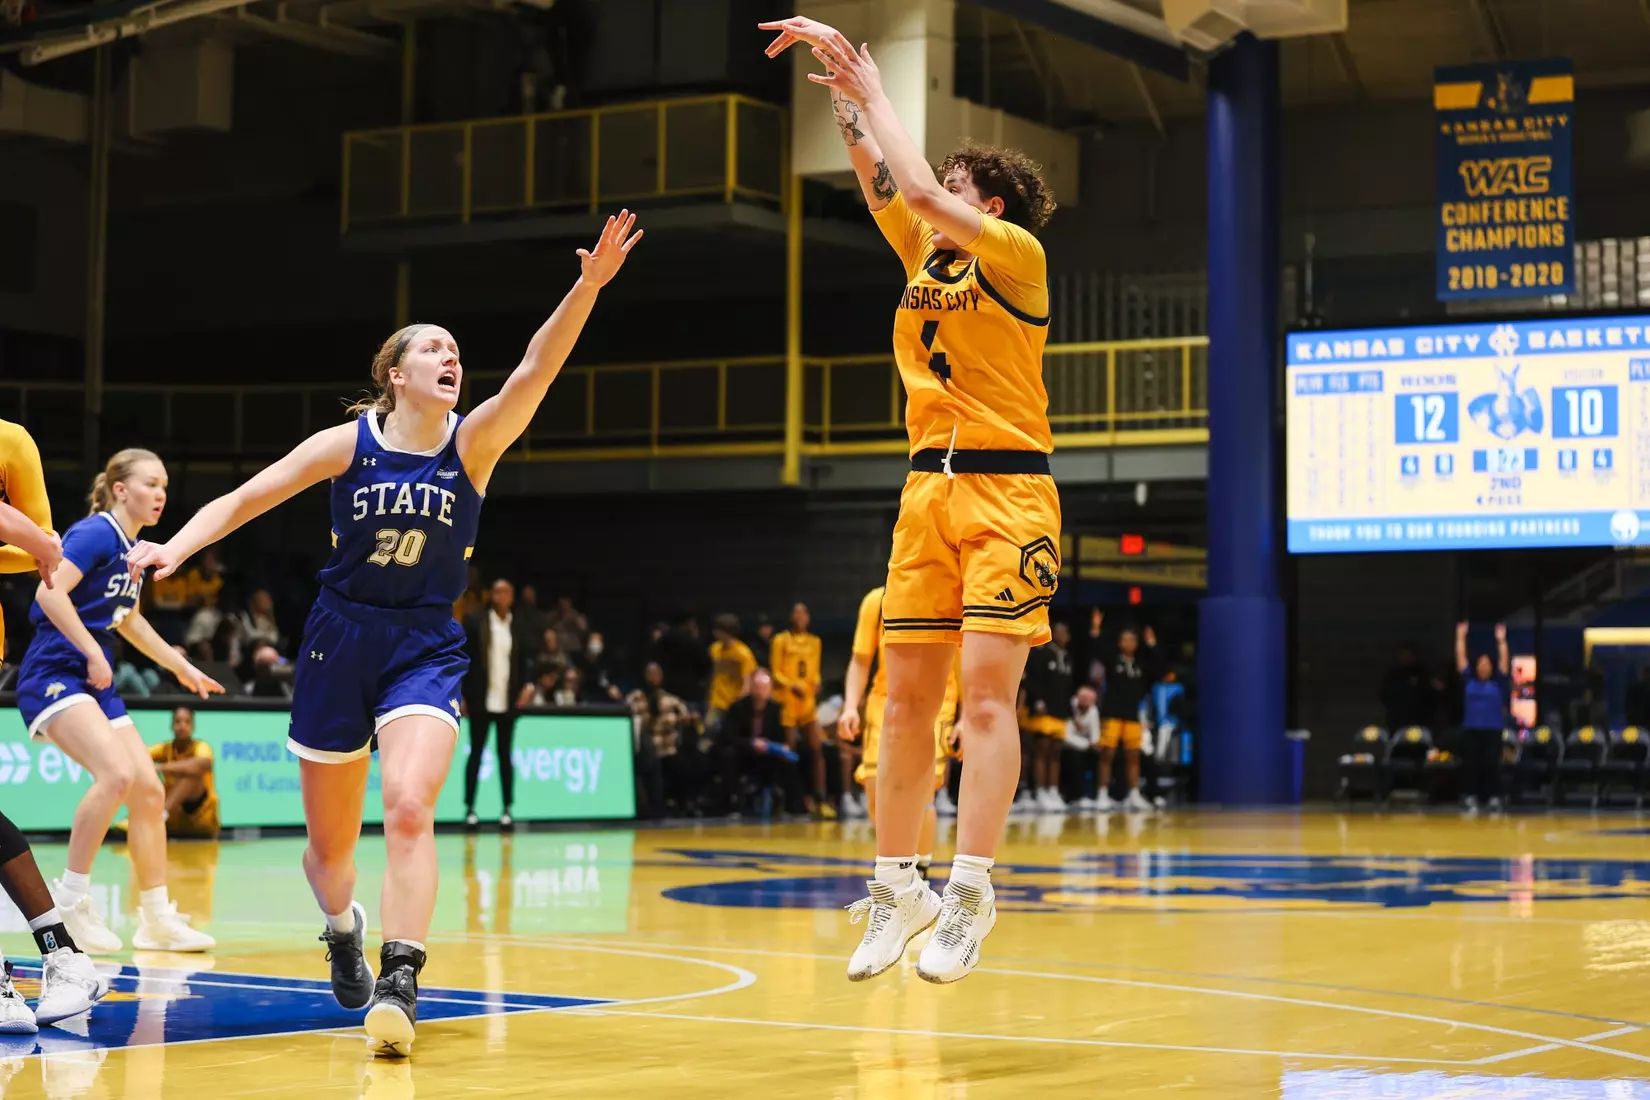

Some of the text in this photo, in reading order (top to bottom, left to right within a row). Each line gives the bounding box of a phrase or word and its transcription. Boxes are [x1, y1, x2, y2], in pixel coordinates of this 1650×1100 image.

[1458, 155, 1552, 196] WAC
[1442, 196, 1569, 226] CONFERENCE
[1446, 223, 1565, 252] CHAMPIONS
[945, 289, 979, 311] CITY
[920, 320, 951, 383] 4
[1296, 337, 1405, 360] KANSAS
[1416, 334, 1480, 355] CITY
[1411, 394, 1446, 441] 12
[1565, 389, 1604, 436] 10
[353, 482, 456, 526] STATE
[367, 528, 427, 567] 20
[510, 746, 603, 793] vergy
